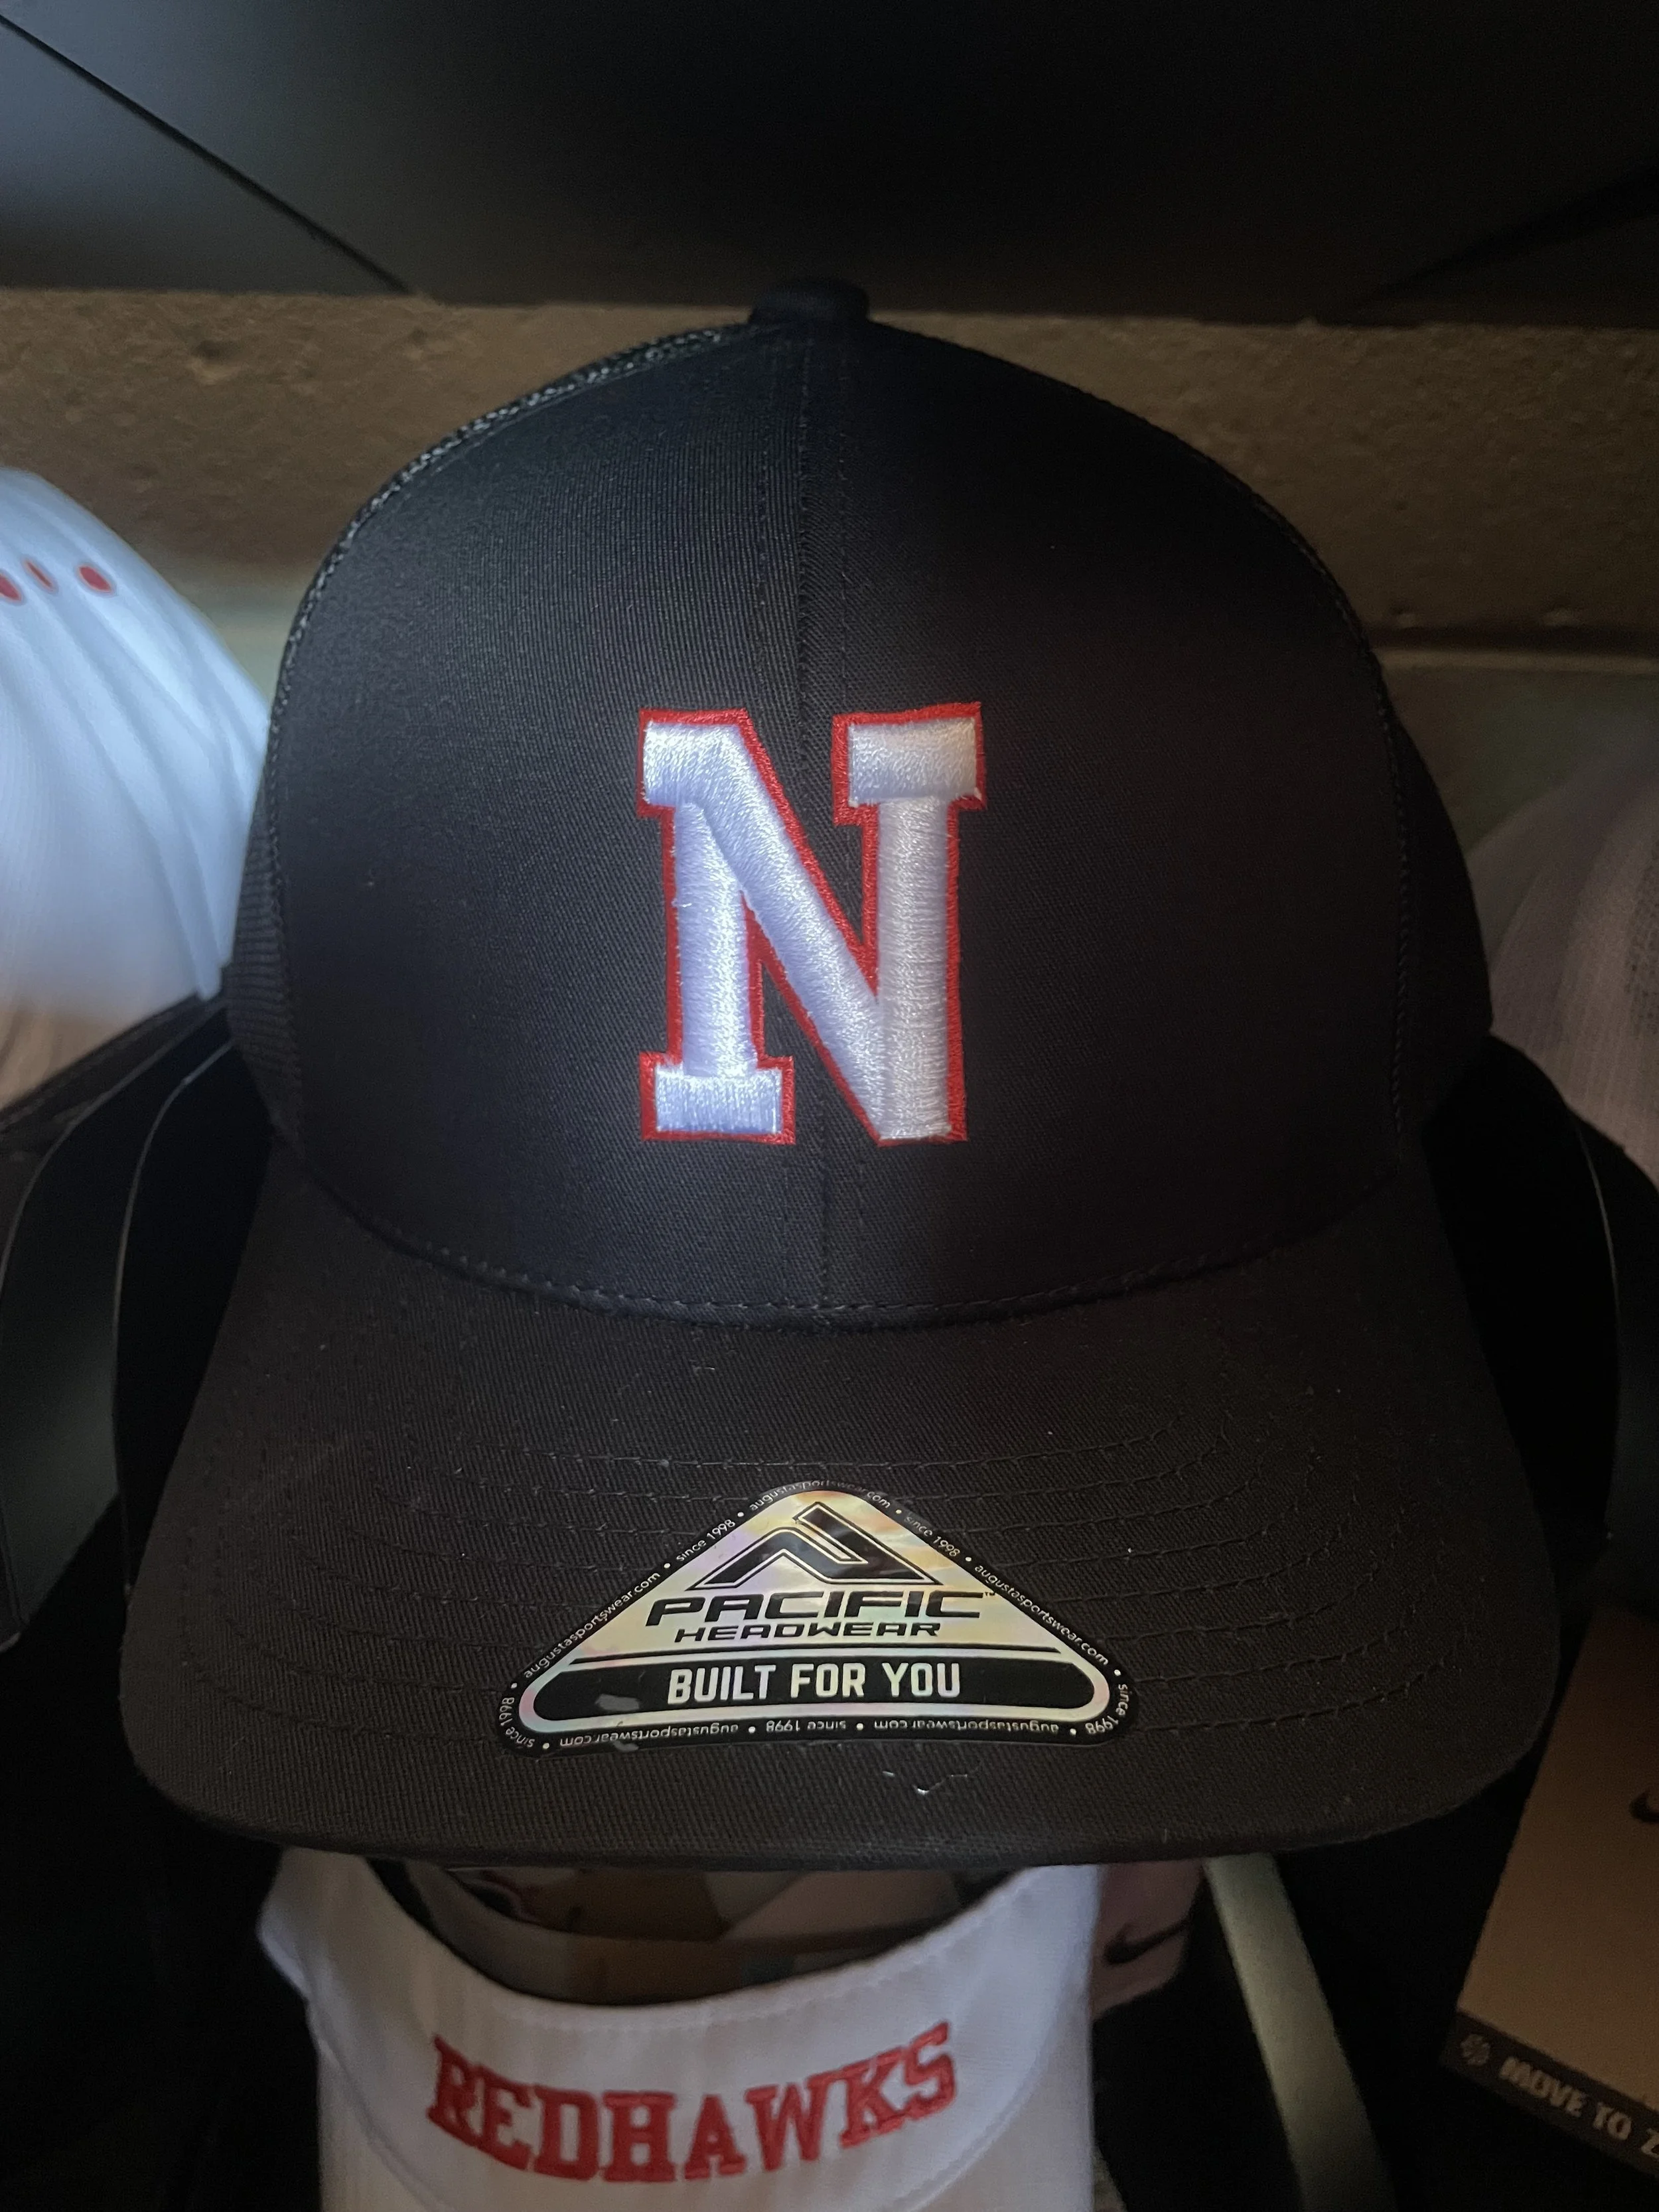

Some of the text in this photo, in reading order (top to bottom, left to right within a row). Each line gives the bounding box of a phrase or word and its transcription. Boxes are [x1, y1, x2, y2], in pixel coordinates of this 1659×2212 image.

[637, 701, 987, 1147] N
[676, 1518, 736, 1562] since 1998
[903, 1515, 961, 1558] since 1998
[524, 1571, 661, 1678] augustasportswear.com
[645, 1591, 983, 1627] PACIFIC
[674, 1622, 940, 1643] HEADWEAR
[974, 1564, 1109, 1666] augustasportswear.com
[667, 1662, 961, 1705] BUILT FOR YOU
[1085, 1683, 1128, 1735] since 1998
[498, 1696, 535, 1748] since 1998
[766, 1720, 800, 1732] 1998
[426, 2021, 957, 2183] REDHAWKS
[1498, 2056, 1587, 2117] MOVE
[1593, 2102, 1632, 2140] TO
